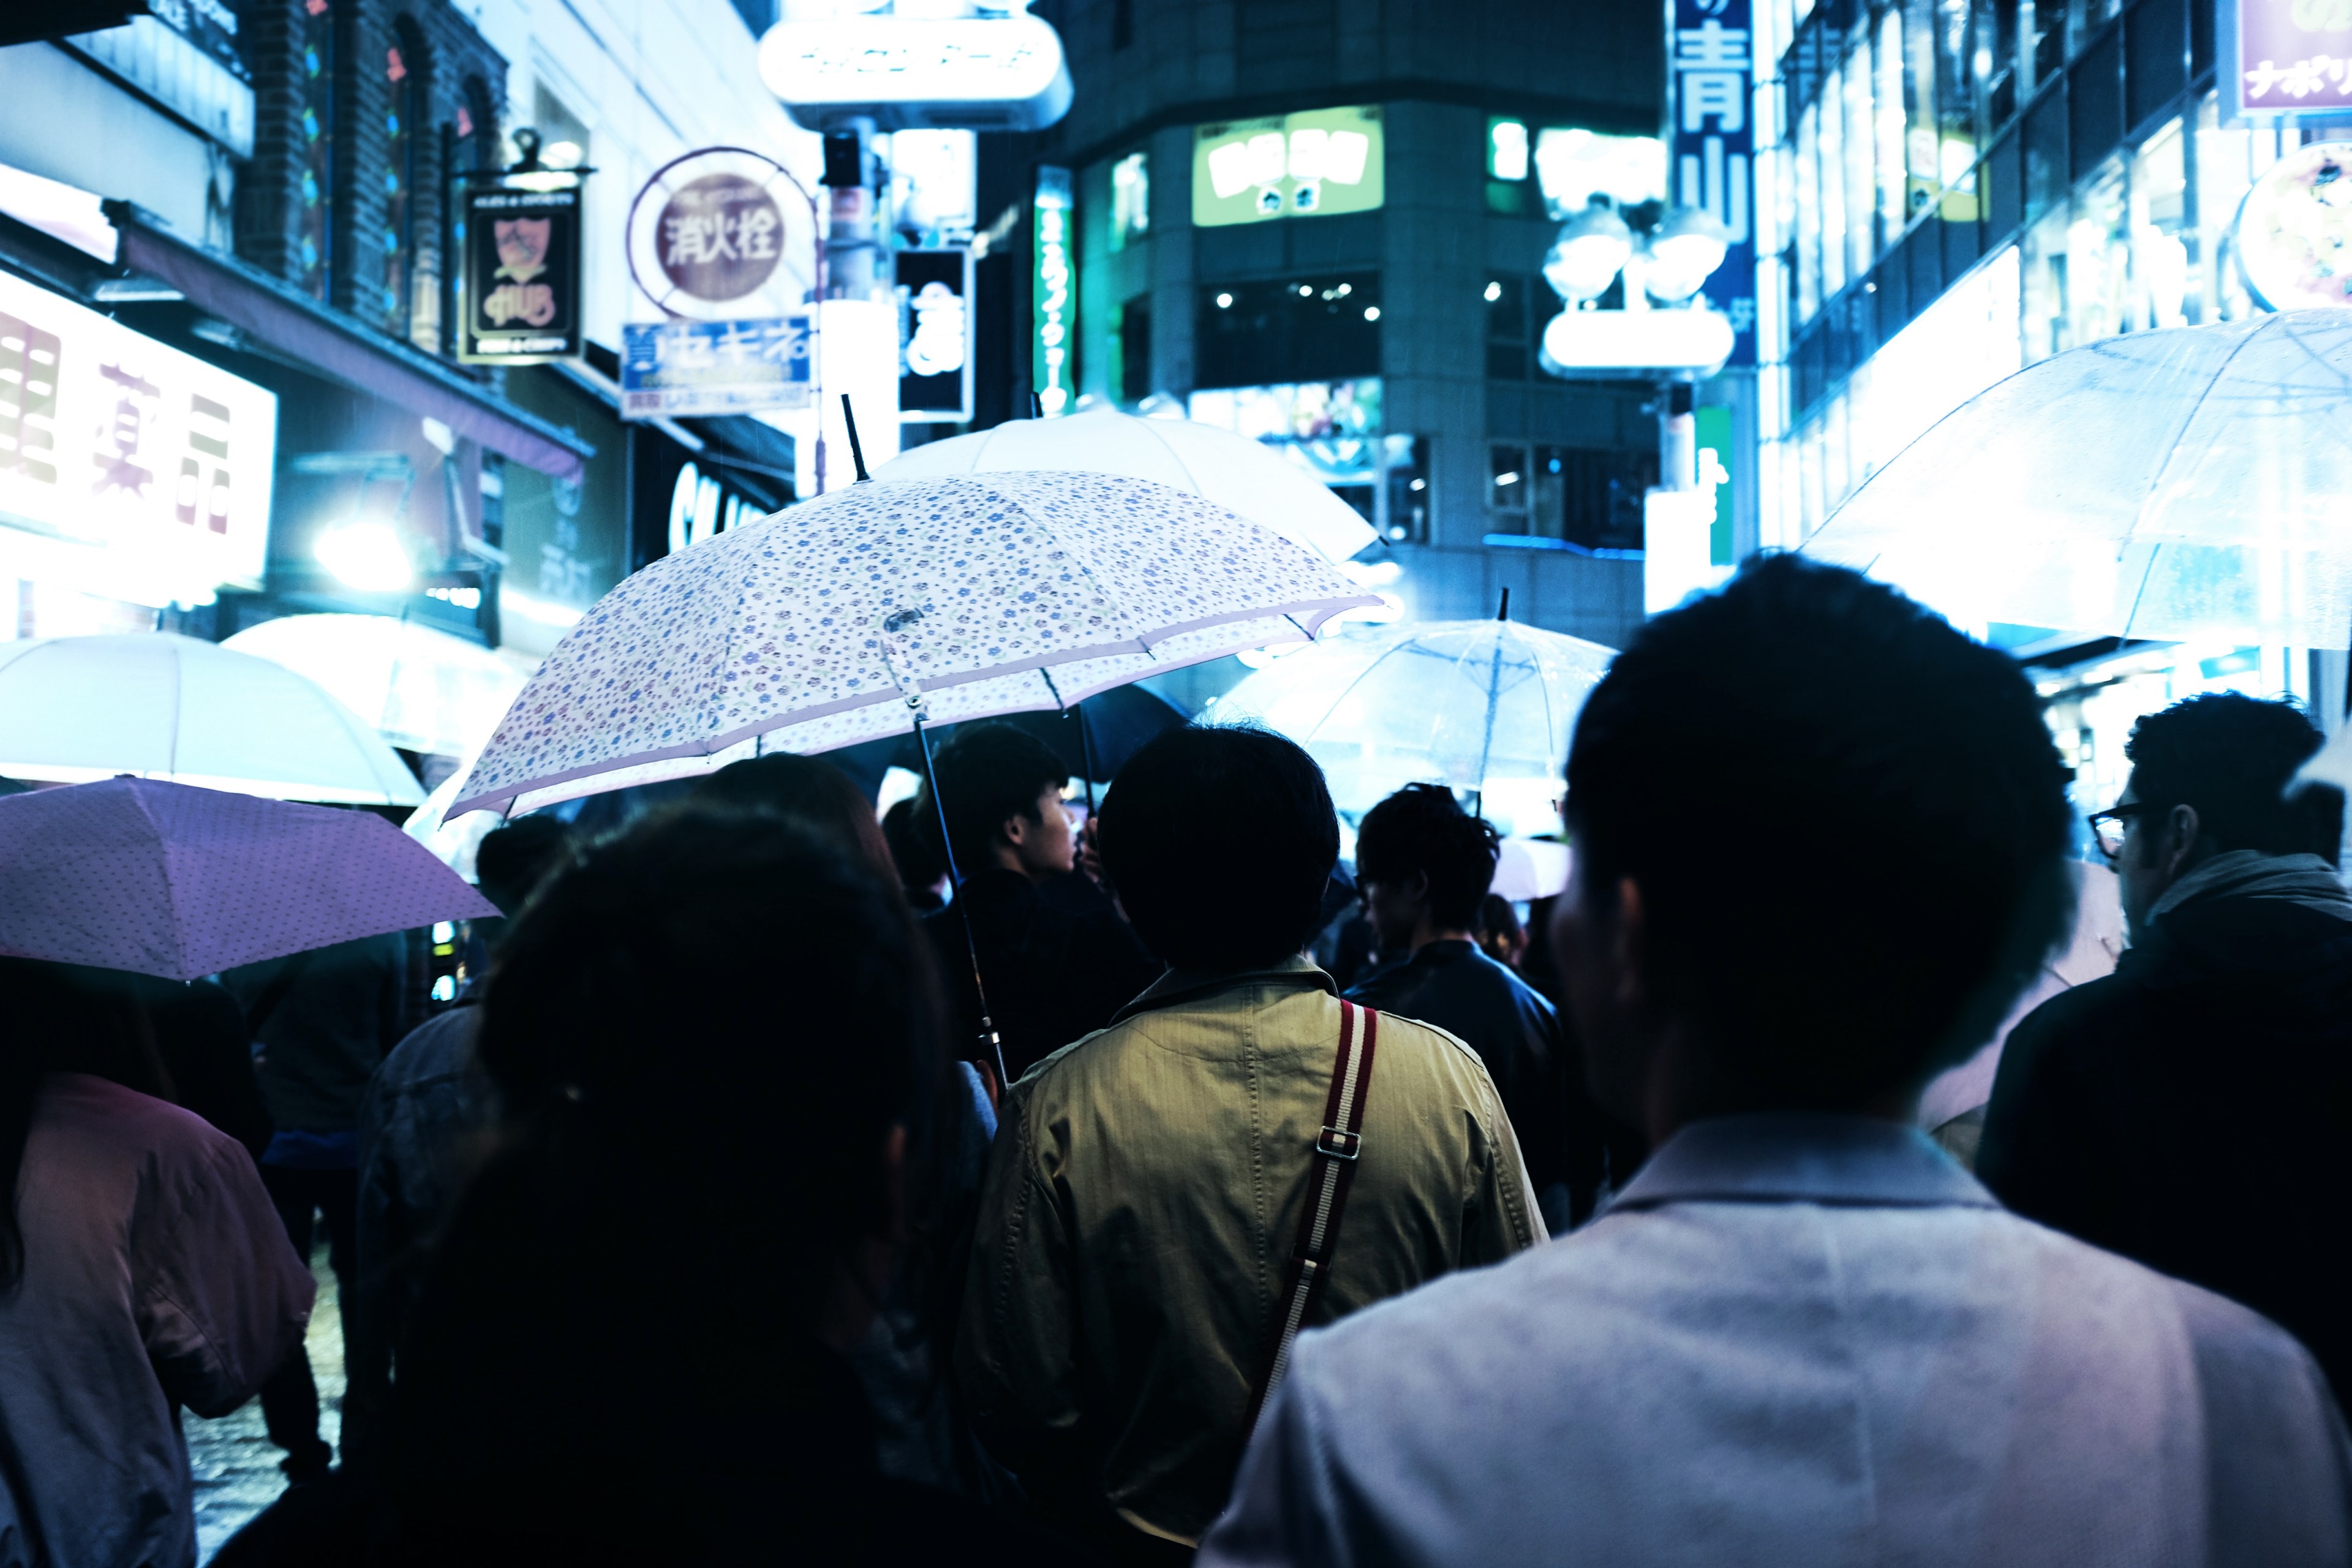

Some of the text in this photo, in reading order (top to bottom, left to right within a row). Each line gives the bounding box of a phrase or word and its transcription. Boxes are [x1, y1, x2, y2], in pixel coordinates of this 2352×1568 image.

[1674, 0, 1751, 244] 青山
[665, 208, 777, 266] 消火栓
[484, 284, 556, 328] HUB
